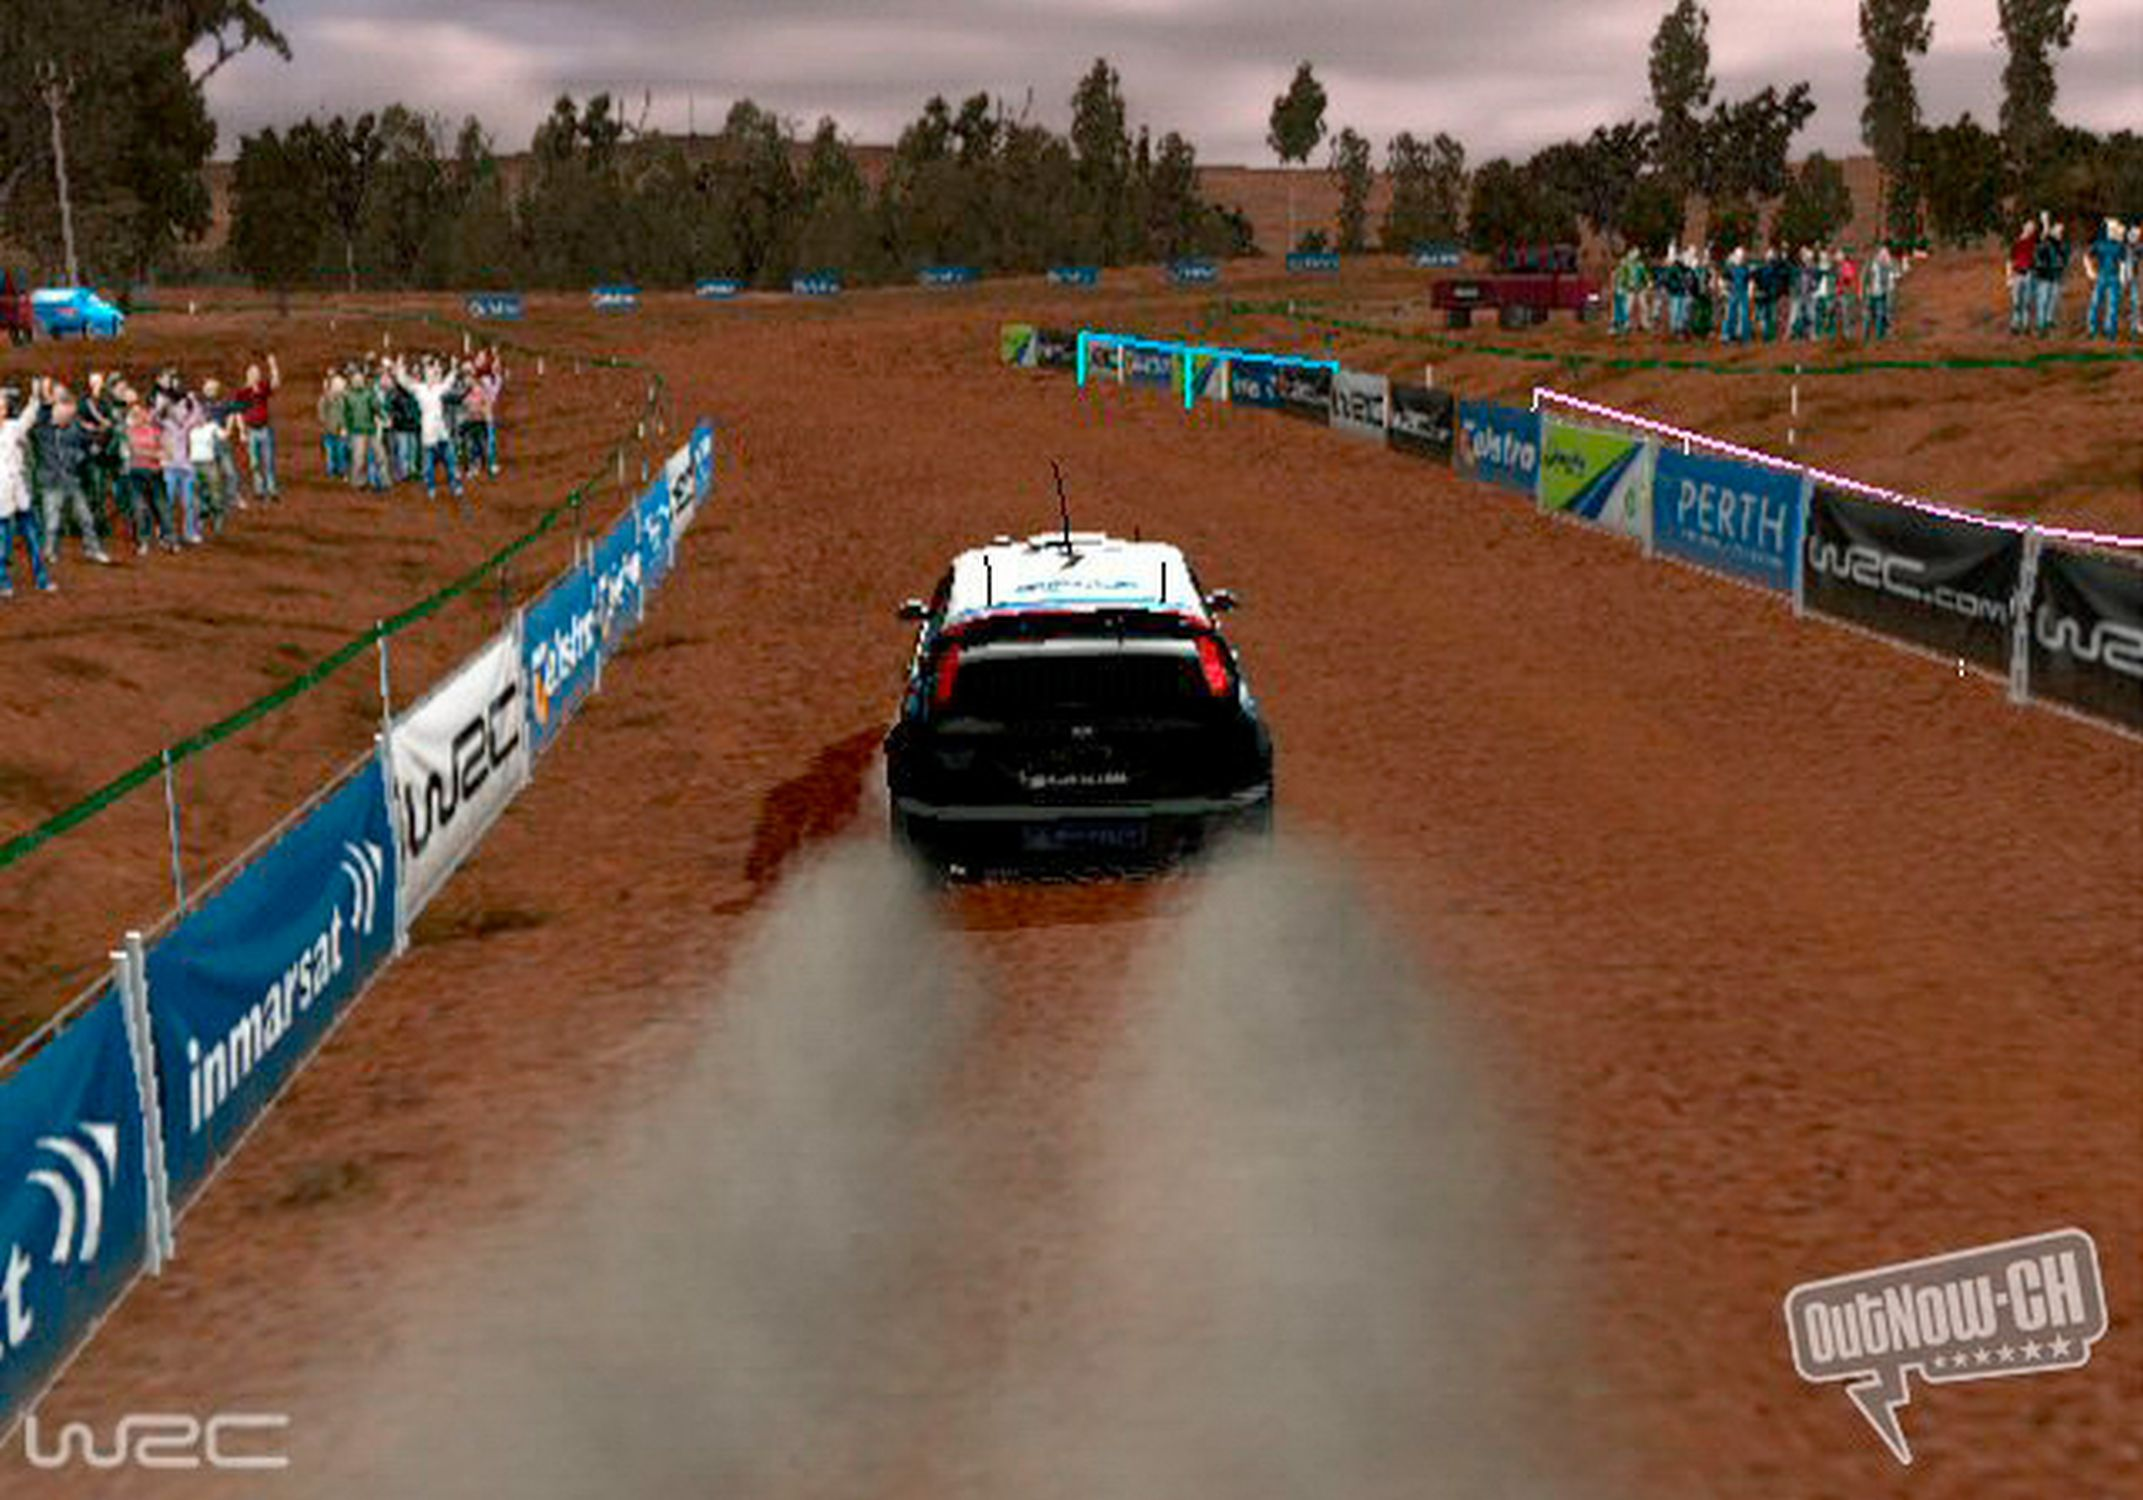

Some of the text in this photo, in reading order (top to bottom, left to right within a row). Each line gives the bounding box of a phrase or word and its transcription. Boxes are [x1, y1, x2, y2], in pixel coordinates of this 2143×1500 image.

[1677, 480, 1787, 553] PERTH
[395, 681, 520, 859] WRC
[187, 903, 343, 1134] inmarsat
